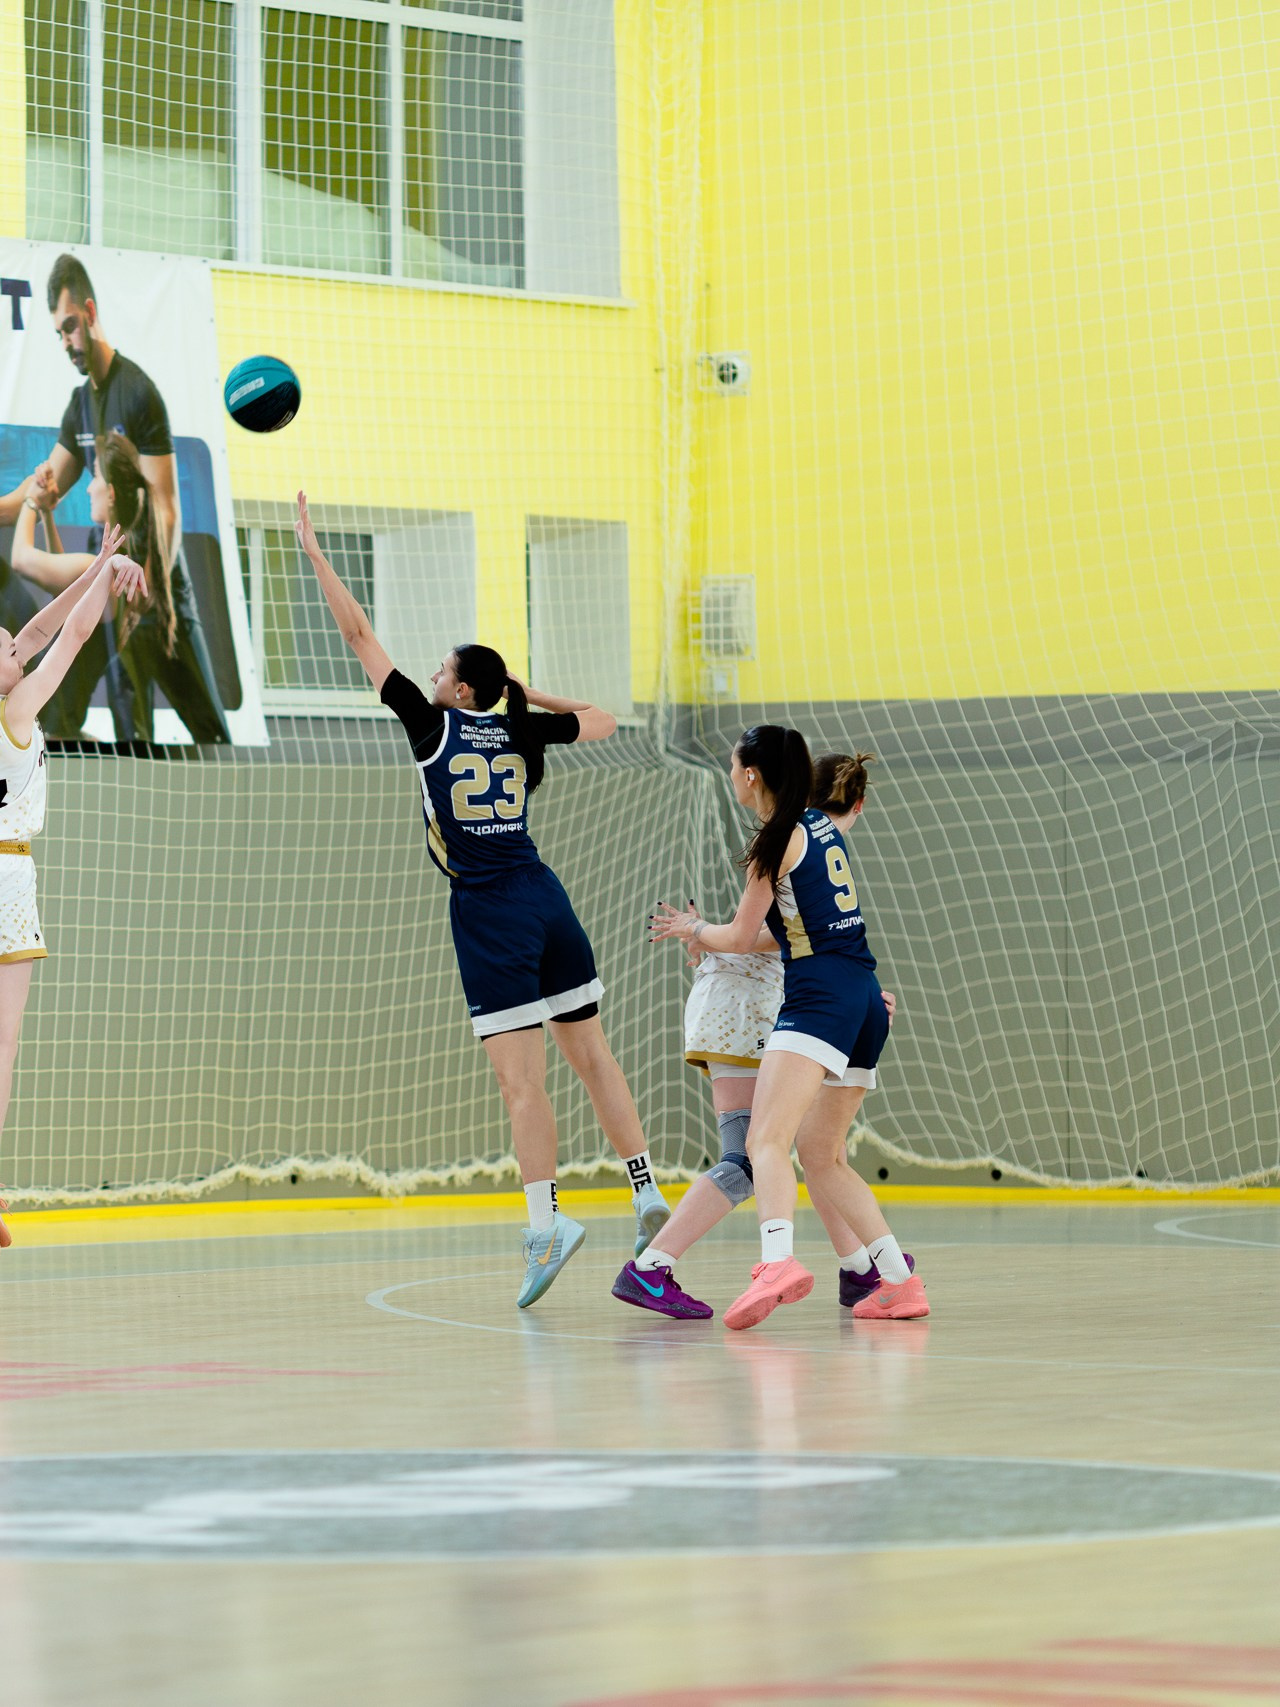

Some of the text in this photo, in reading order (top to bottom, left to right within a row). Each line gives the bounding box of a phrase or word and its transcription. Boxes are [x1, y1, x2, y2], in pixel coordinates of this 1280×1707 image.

[461, 724, 508, 735] РОССИЙСКИ
[448, 753, 527, 820] 23
[825, 845, 858, 912] 9
